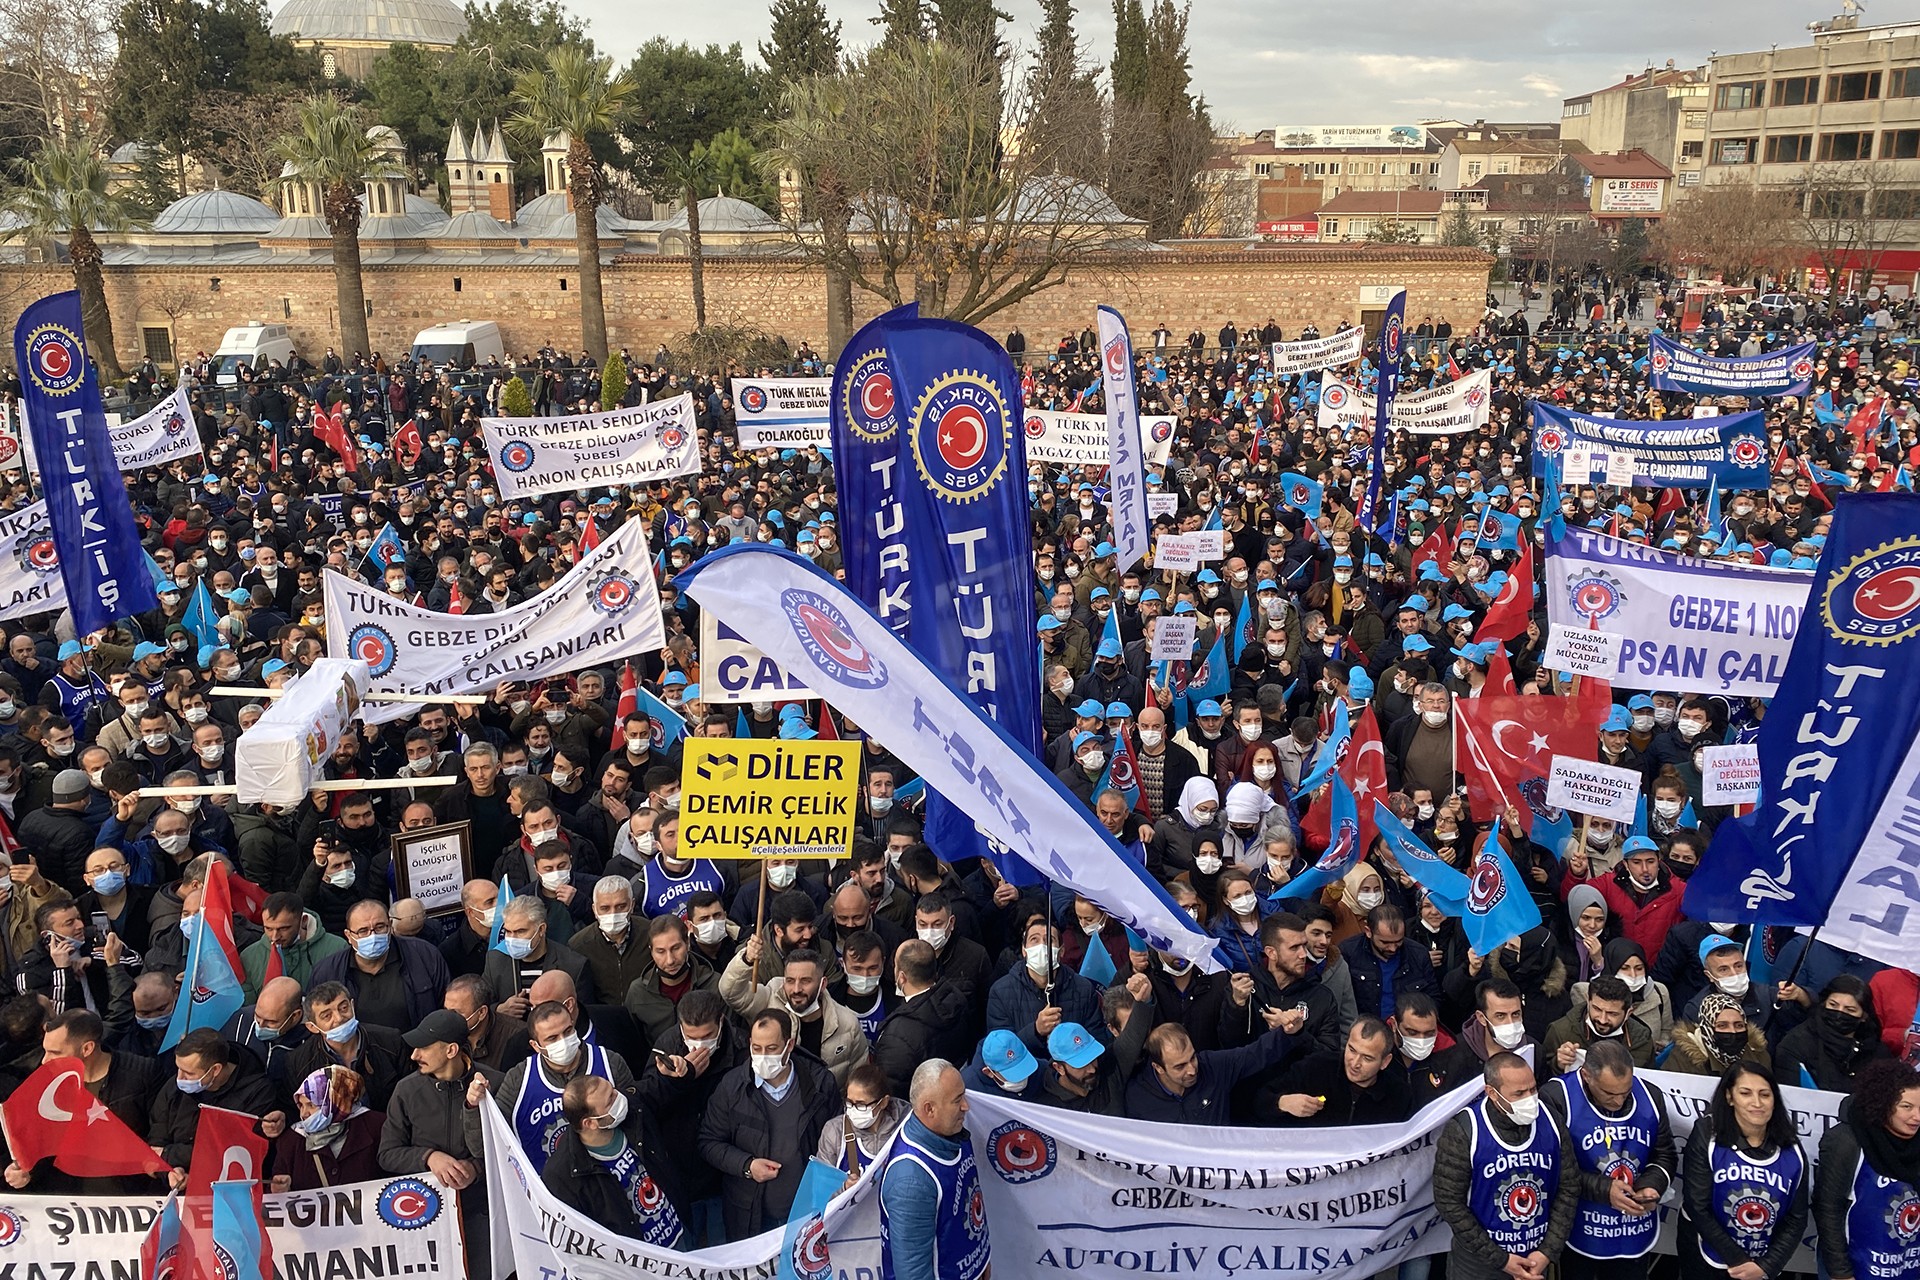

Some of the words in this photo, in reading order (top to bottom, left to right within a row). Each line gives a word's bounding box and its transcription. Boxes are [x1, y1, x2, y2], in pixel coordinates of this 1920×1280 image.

[1619, 181, 1630, 189] BT
[1631, 179, 1659, 189] SERVİS
[1285, 344, 1301, 352] TÜRK
[1673, 350, 1699, 364] TÜRK
[1733, 356, 1787, 371] SENDİKASI
[770, 386, 796, 399] TÜRK
[797, 386, 827, 399] METAL
[780, 400, 805, 410] GEBZE
[807, 398, 829, 409] DİLOV
[495, 424, 538, 438] TÜRK
[544, 419, 598, 435] METAL
[603, 403, 684, 428] SENDİKASI
[1055, 416, 1089, 431] TÜRK
[588, 429, 647, 449] DİLOVASI
[757, 426, 824, 444] ÇOLAKOĞLU
[1061, 432, 1109, 446] SENDİK
[1570, 417, 1602, 438] TÜRK
[1603, 427, 1644, 445] METAL
[1645, 426, 1721, 446] SENDİKASI
[573, 447, 620, 464] ŞUBESİ
[1029, 445, 1073, 459] AYGAZ
[1655, 450, 1689, 461] YAKASI
[1690, 446, 1725, 462] ŞUBESİ
[516, 470, 576, 490] HANON
[581, 456, 681, 484] ÇALIŞANLARI
[1650, 464, 1708, 480] ÇALIŞANLARI
[1669, 594, 1739, 634] GEBZE
[1747, 602, 1755, 636] 1
[407, 630, 477, 647] GEBZE
[1563, 629, 1608, 645] UZLAŞMA
[466, 622, 625, 684] ÇALIŞANLARI
[1568, 641, 1600, 654] YOKSA
[1556, 648, 1608, 665] MÜCADELE
[1618, 639, 1708, 678] PSAN
[1570, 661, 1590, 672] VAR
[748, 747, 844, 780] DİLER
[1712, 759, 1733, 768] ASLA
[1736, 758, 1759, 766] YALN
[1556, 767, 1599, 784] SADAKA
[1601, 775, 1634, 791] DEĞİL
[1563, 780, 1622, 799] HAKKIMIZI
[688, 791, 773, 814] DEMİR
[781, 792, 848, 820] ÇELİK
[1571, 791, 1612, 807] İSTERİZ
[685, 825, 847, 849] ÇALIŞANLARI
[420, 843, 447, 854] İŞÇİLİK
[751, 845, 846, 855] #ÇeliğeŞekilVerenleriz
[412, 853, 458, 868] ÖLMÜŞTÜR
[420, 873, 453, 887] BAŞIMIZ
[659, 880, 713, 908] GÖREVLİ
[1582, 1125, 1651, 1151] GÖREVLİ
[1483, 1152, 1553, 1179] GÖREVLİ
[1168, 1164, 1278, 1190] METAL
[1714, 1162, 1792, 1195] GÖREVLİ
[384, 1182, 431, 1200] TÜRK-İŞ
[1111, 1187, 1194, 1209] GEBZE
[1327, 1179, 1408, 1223] ŞUBESİ
[1583, 1211, 1619, 1226] TÜRK
[538, 1205, 608, 1260] TÜRK
[1487, 1229, 1522, 1242] TÜRK
[1583, 1220, 1653, 1238] SENDİKASI
[1036, 1241, 1206, 1273] AUTOLİV
[1870, 1250, 1904, 1264] TÜRK
